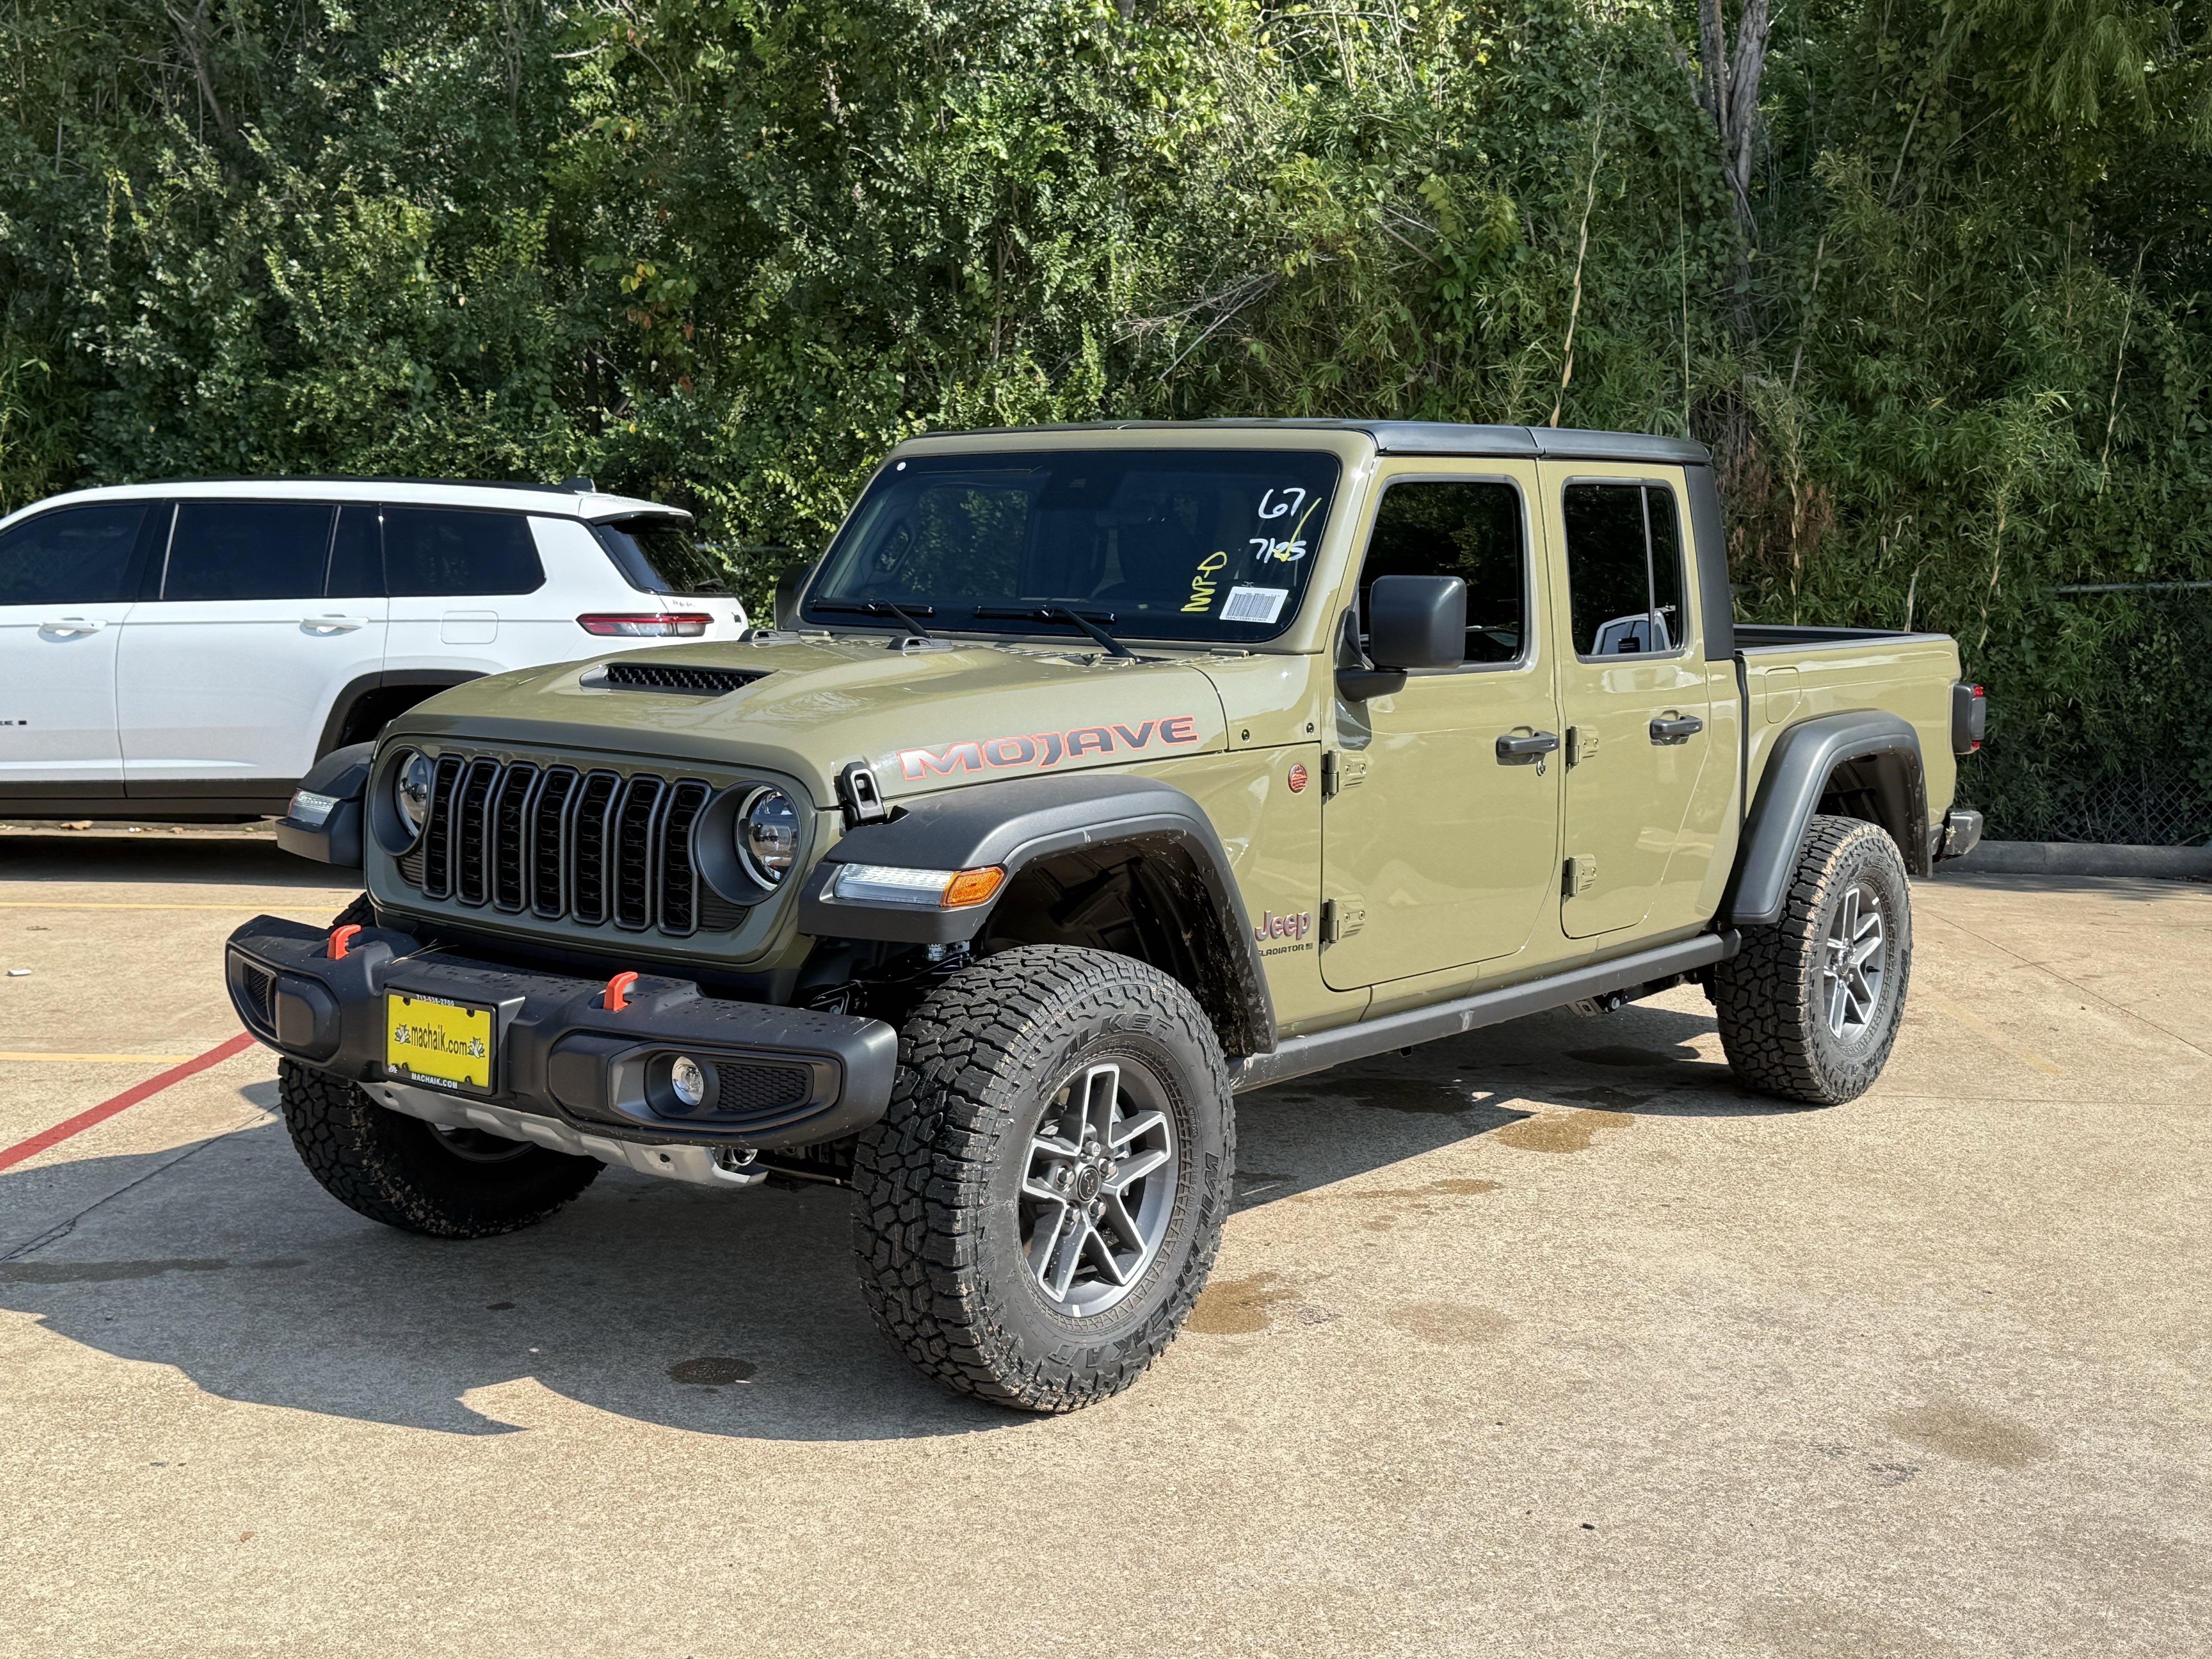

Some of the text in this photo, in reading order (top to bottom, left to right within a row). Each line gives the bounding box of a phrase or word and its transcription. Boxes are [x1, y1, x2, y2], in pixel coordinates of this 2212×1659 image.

[1258, 487, 1306, 519] 67
[896, 715, 1199, 781] MOJAVE
[1254, 910, 1311, 941] Jeep
[411, 1022, 467, 1056] machaik.com
[1032, 1012, 1175, 1103] FALKEN
[411, 1072, 458, 1089] MACHAIK.COM
